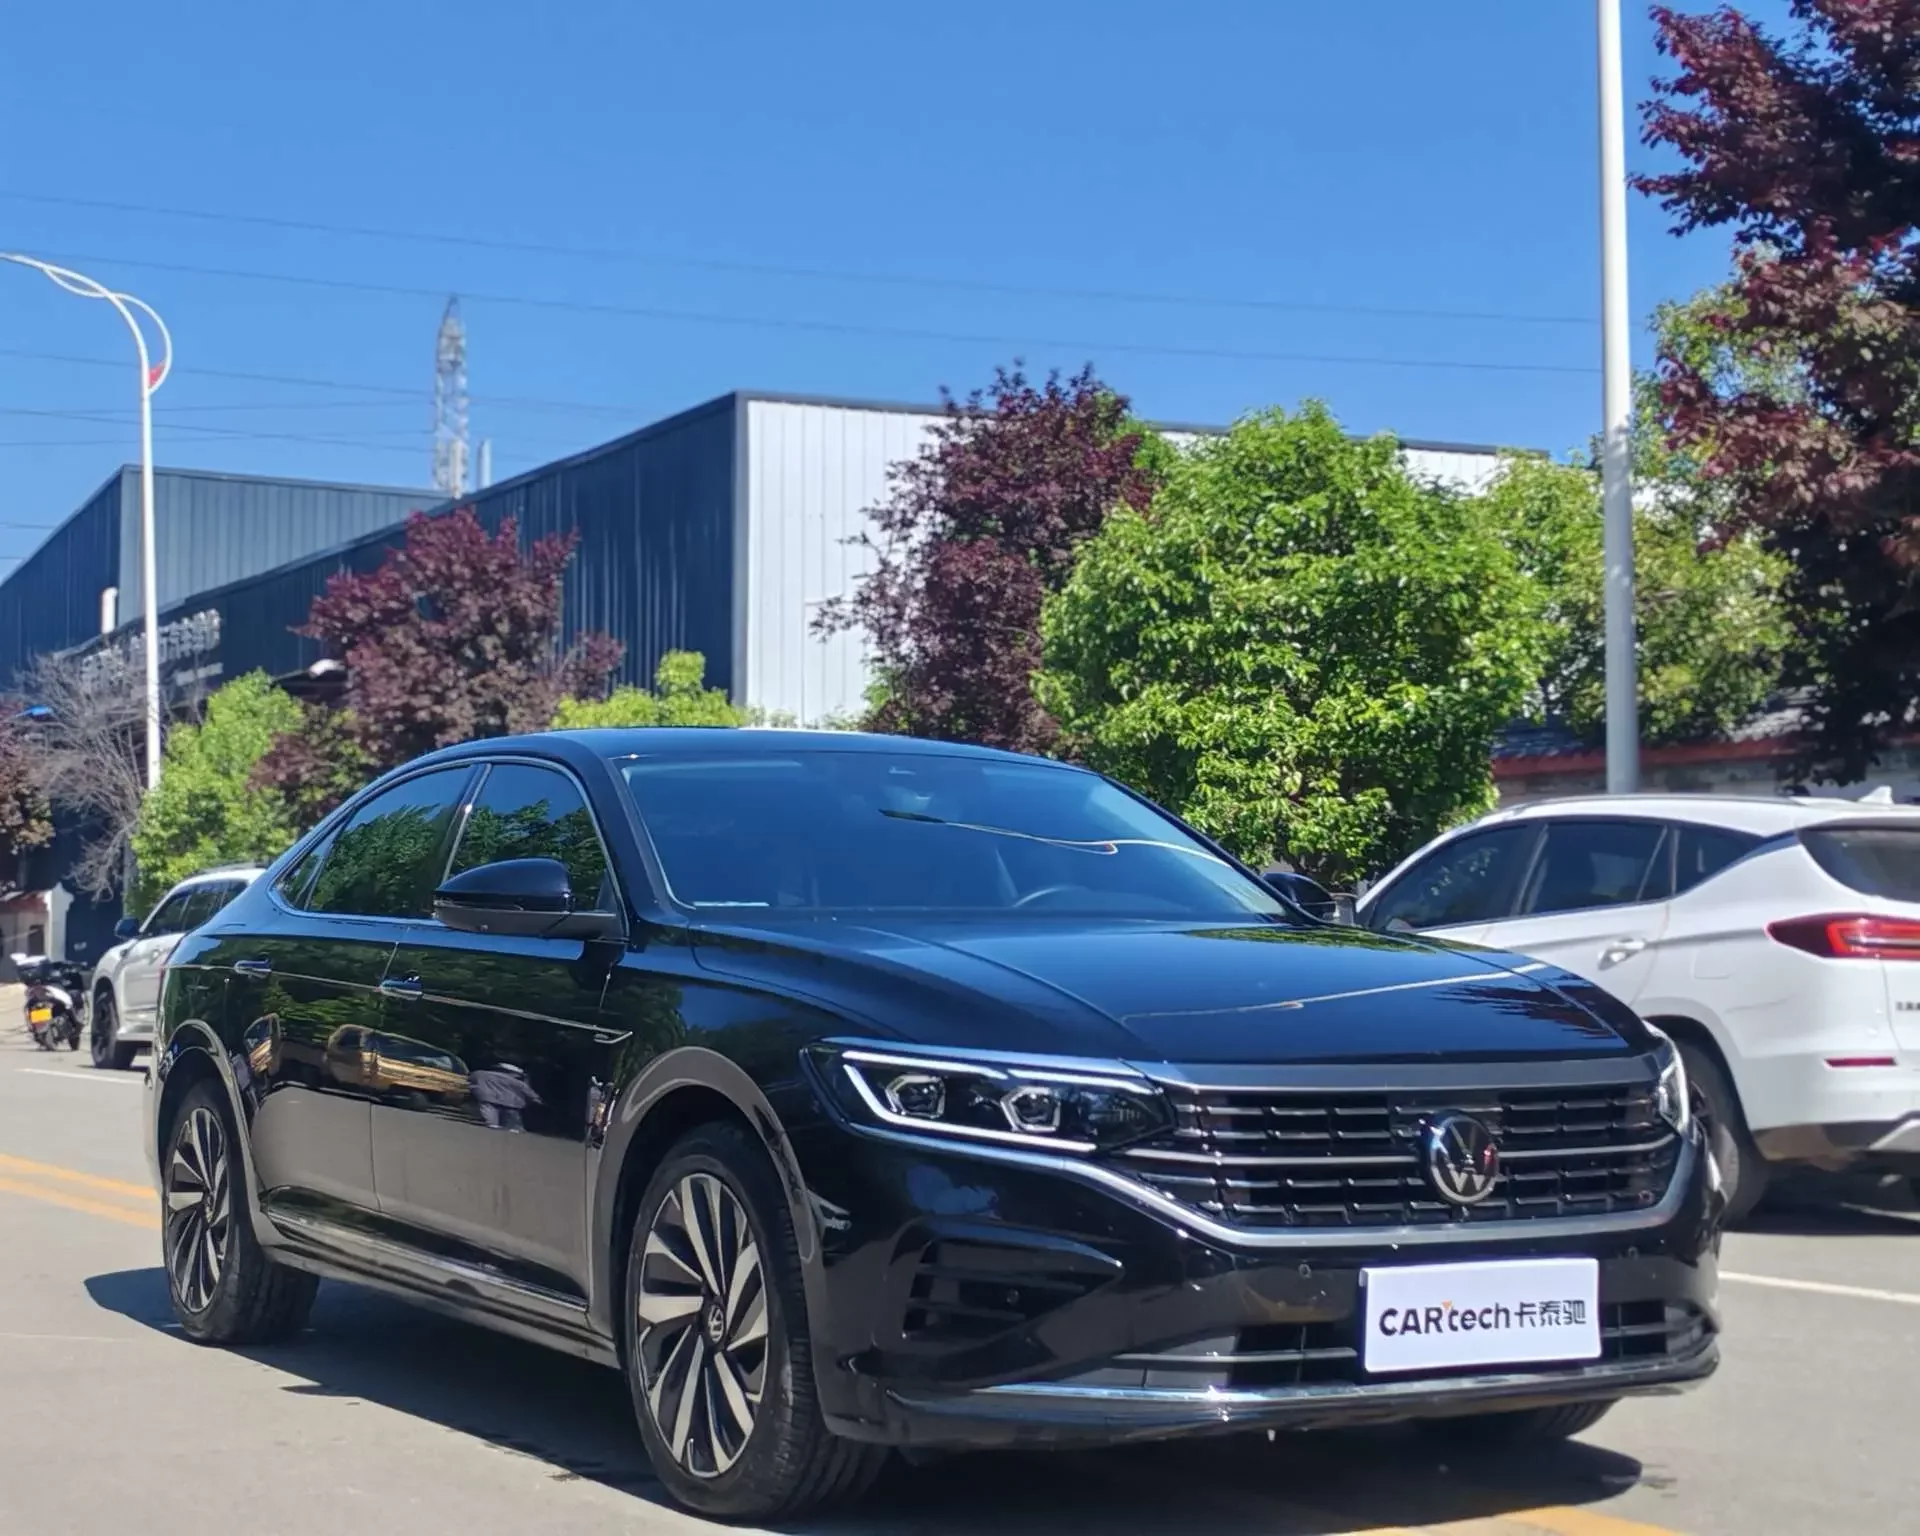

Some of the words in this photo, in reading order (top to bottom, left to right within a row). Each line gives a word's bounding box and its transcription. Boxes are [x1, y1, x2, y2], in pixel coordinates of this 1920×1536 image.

[1379, 1302, 1511, 1336] CARtech
[1514, 1300, 1587, 1327] 卡泰驰
